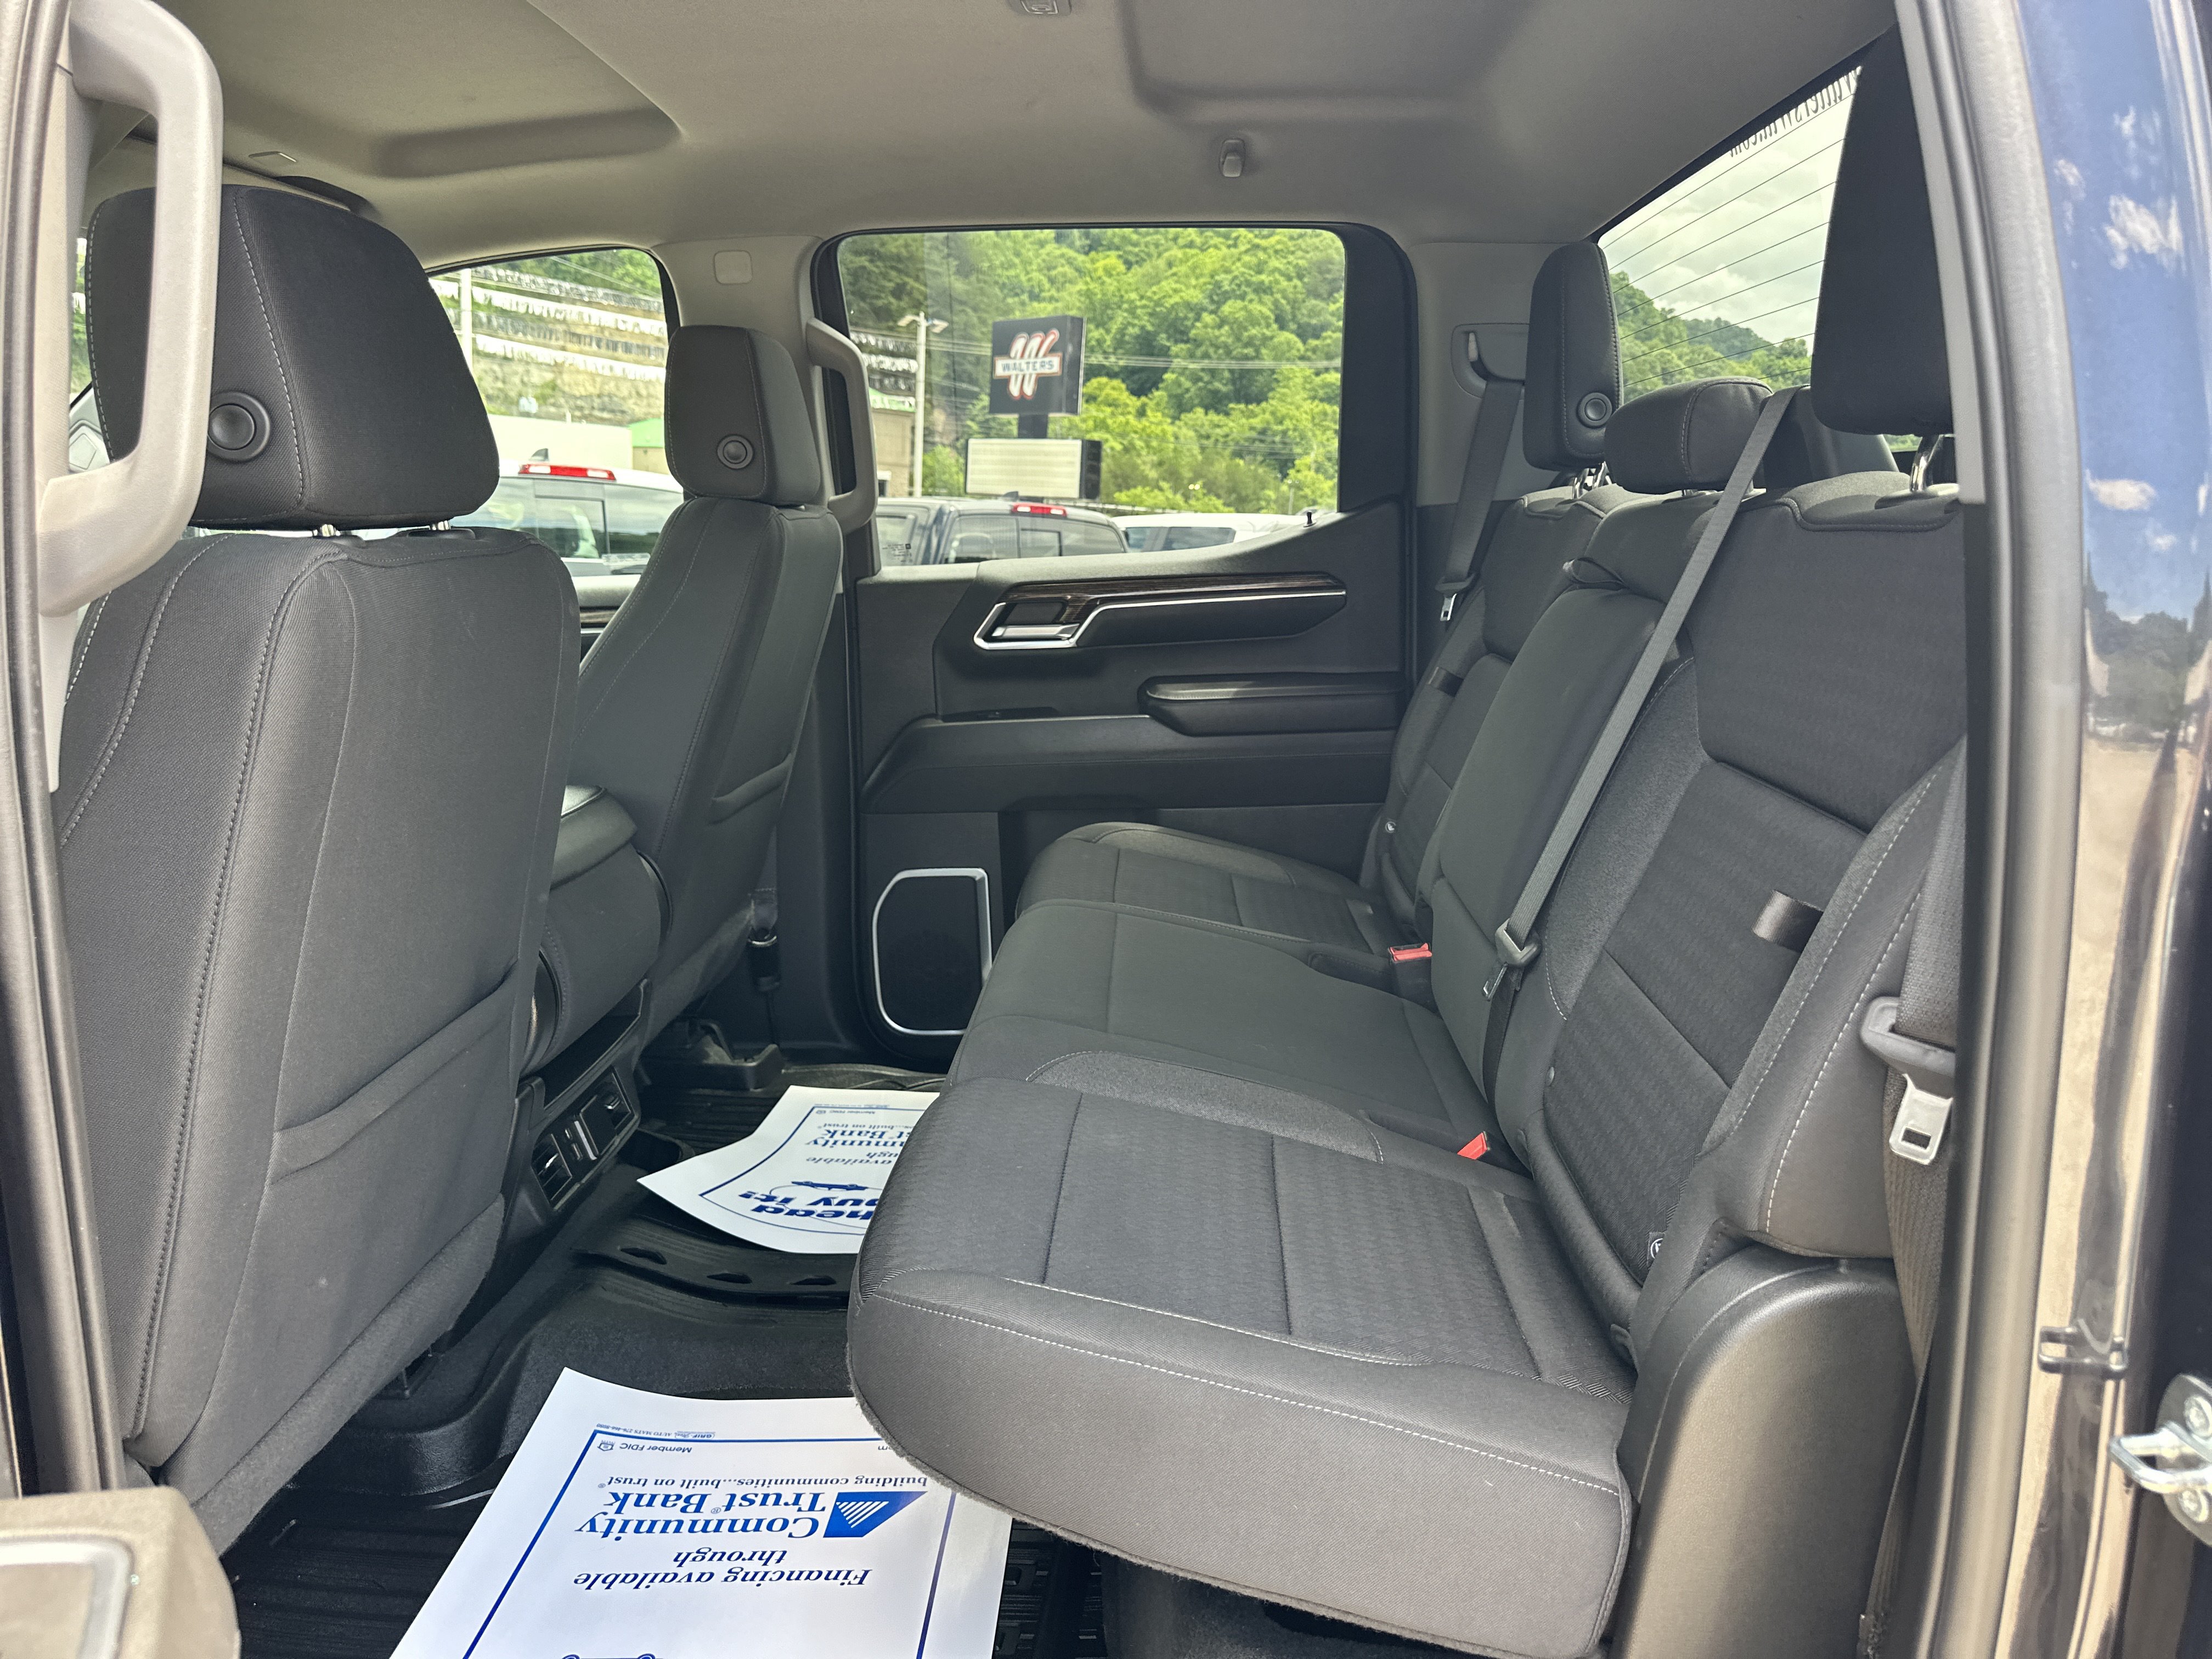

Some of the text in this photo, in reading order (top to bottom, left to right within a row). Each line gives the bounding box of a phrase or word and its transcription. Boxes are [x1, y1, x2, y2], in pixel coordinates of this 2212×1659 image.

[822, 1129, 886, 1139] Bank
[806, 1156, 893, 1165] available
[738, 1191, 796, 1204] it!
[751, 1204, 874, 1220] head
[619, 1442, 692, 1453] Member FDIC
[855, 1475, 928, 1487] building
[603, 1492, 704, 1515] Bank
[574, 1512, 820, 1540] Community
[674, 1547, 788, 1565] through
[573, 1566, 872, 1590] Financing available
